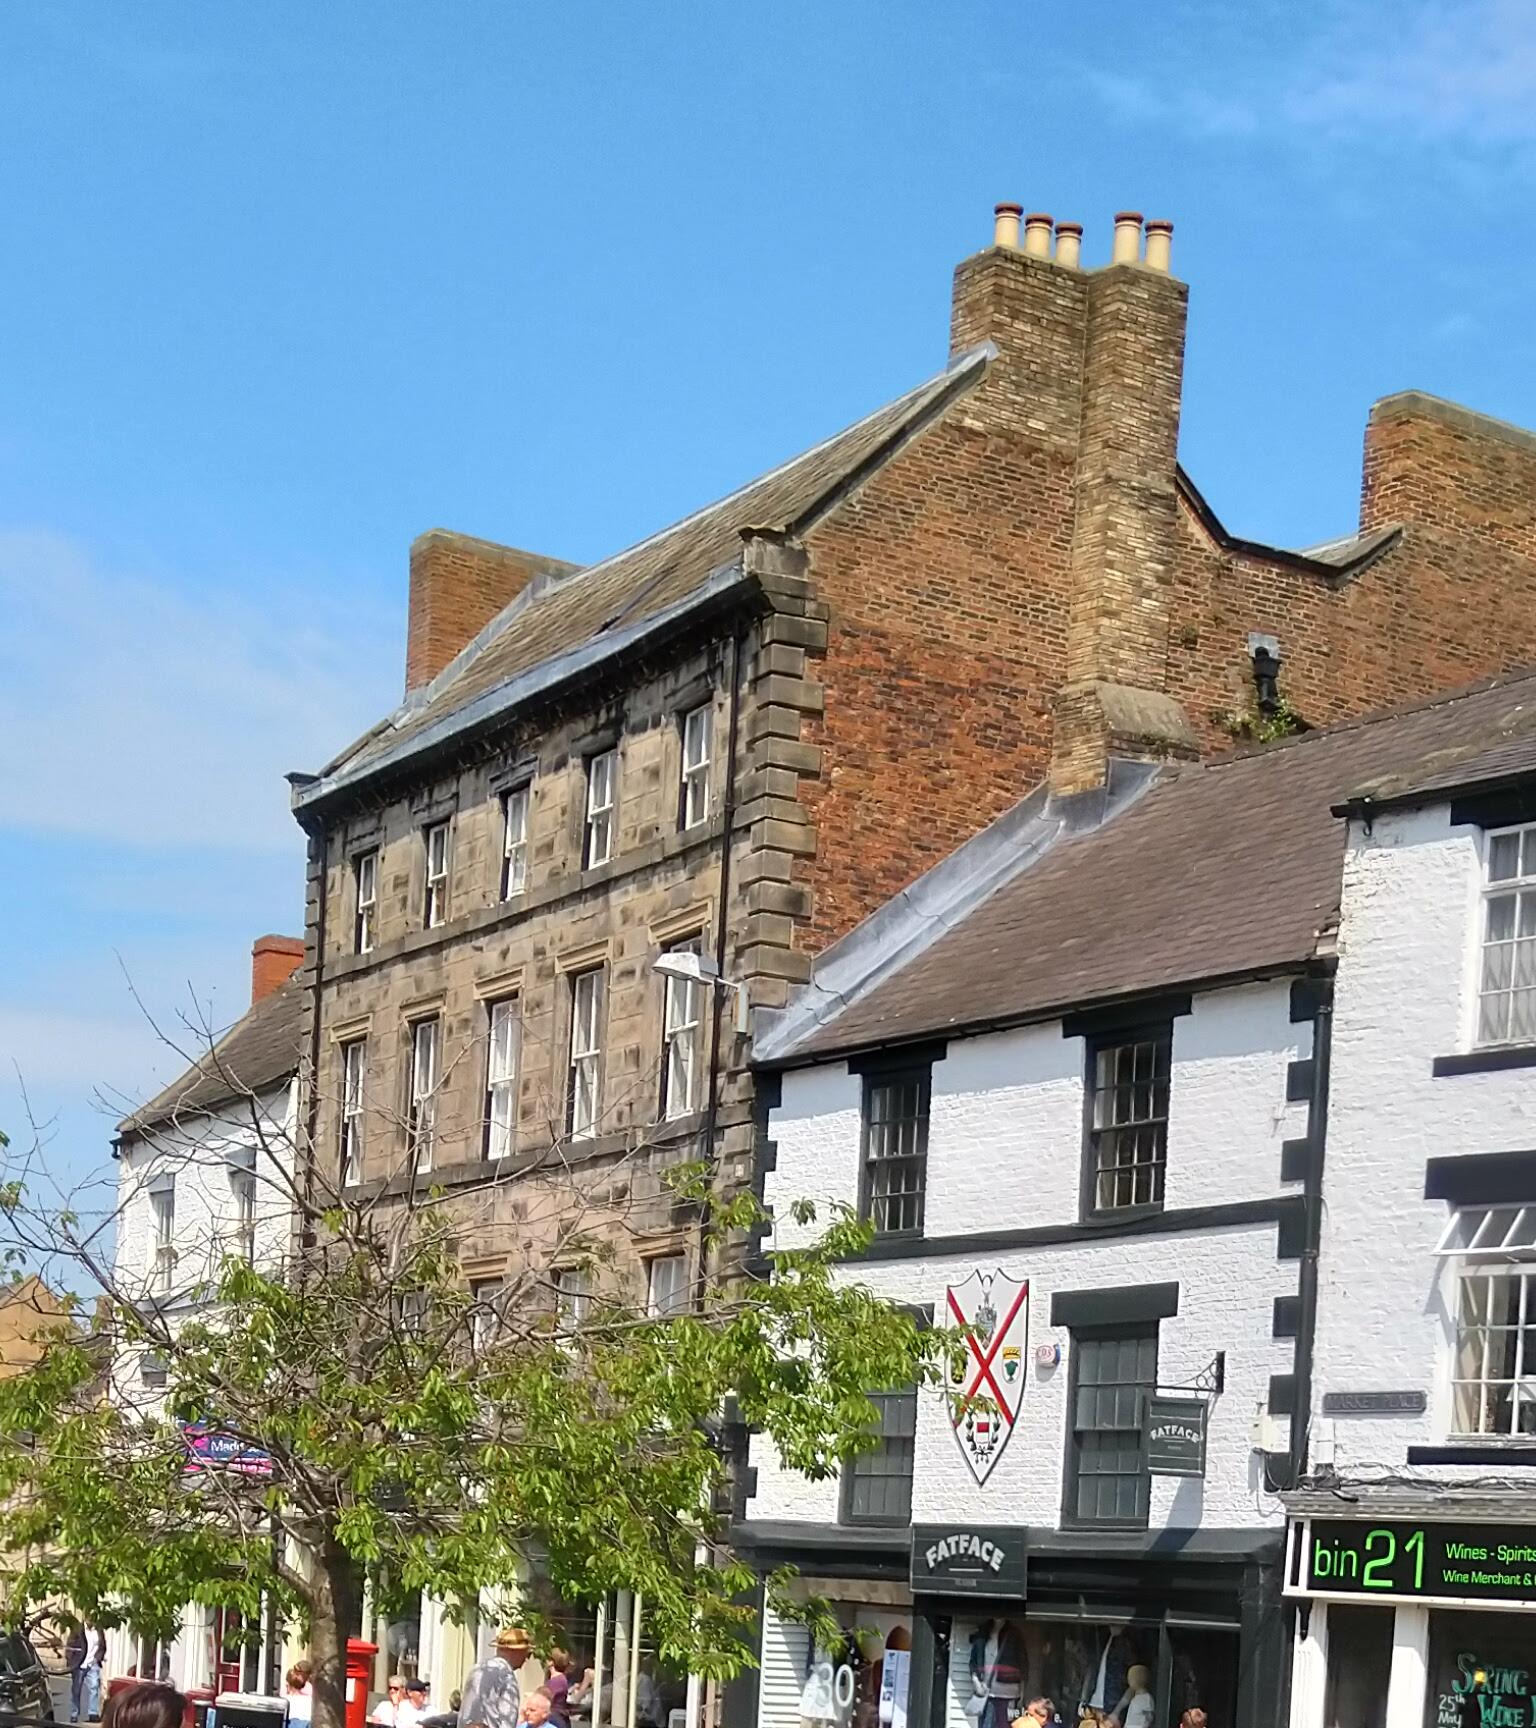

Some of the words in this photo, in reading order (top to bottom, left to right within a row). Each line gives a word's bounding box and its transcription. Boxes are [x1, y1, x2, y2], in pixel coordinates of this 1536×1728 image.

[1150, 1424, 1201, 1443] FATFACE
[925, 1533, 1006, 1572] FATFACE
[1446, 1542, 1487, 1560] Wines
[1443, 1569, 1469, 1583] Wine
[1471, 1571, 1522, 1586] Merchant
[1523, 1573, 1532, 1586] &
[1439, 1693, 1466, 1713] 25th
